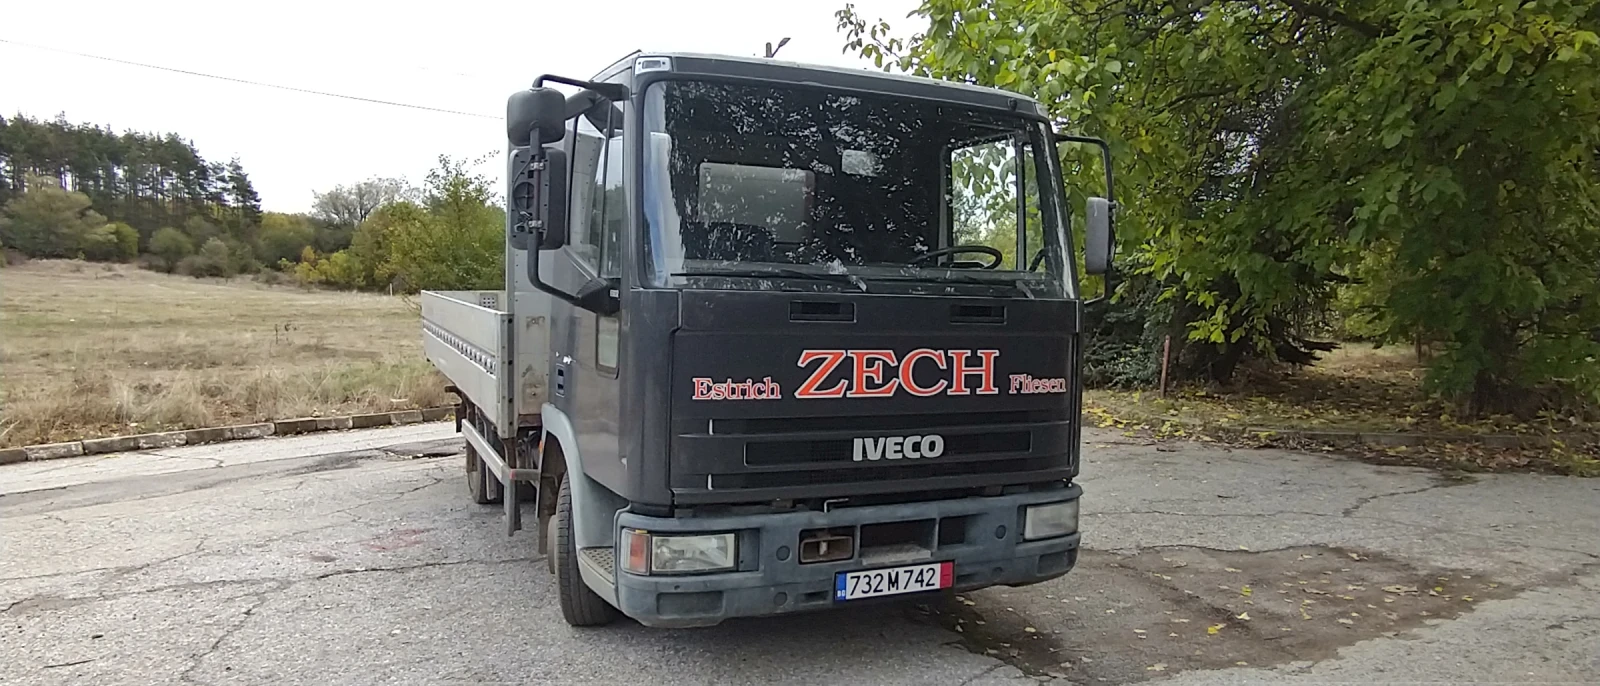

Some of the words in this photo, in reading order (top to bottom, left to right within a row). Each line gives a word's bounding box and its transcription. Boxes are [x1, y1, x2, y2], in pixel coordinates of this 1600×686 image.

[692, 377, 781, 400] Estrich
[794, 348, 1000, 399] ZECH
[1009, 373, 1067, 395] Fliesen
[852, 434, 944, 461] IVECO
